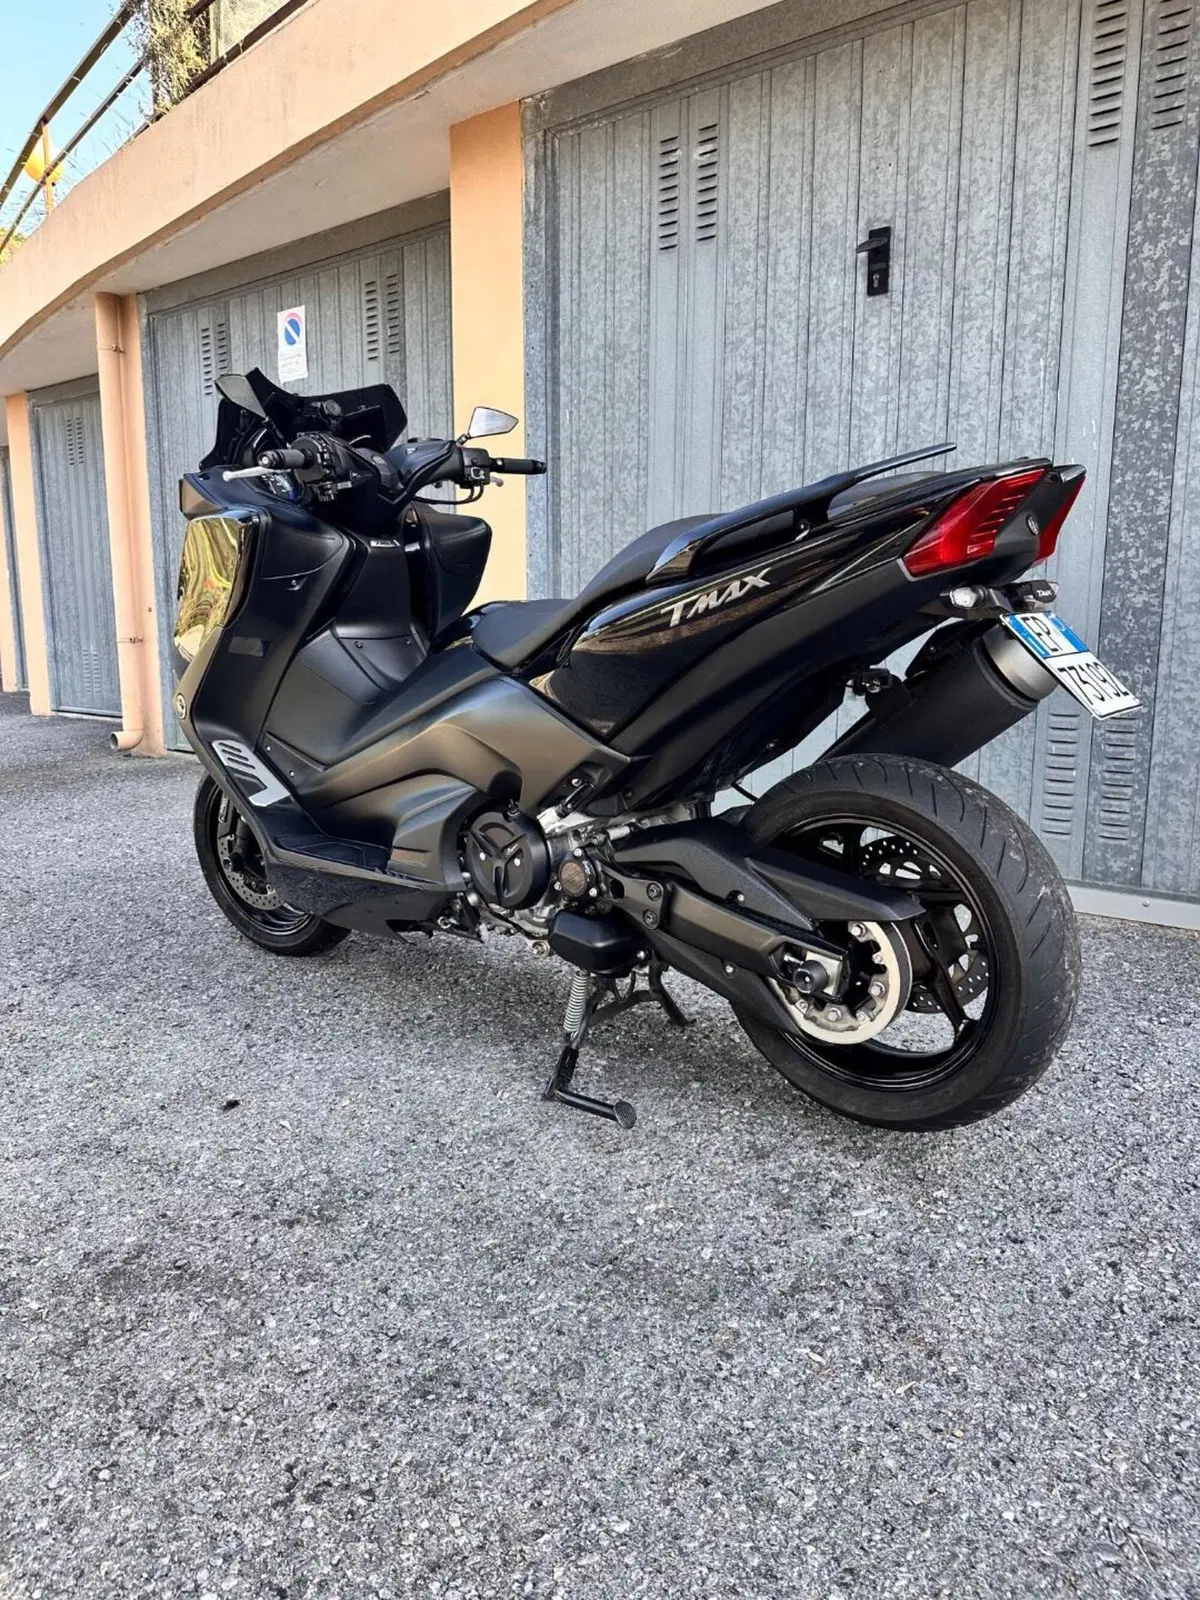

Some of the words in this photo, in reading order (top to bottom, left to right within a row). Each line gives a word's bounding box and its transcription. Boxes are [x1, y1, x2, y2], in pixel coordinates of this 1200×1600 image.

[660, 566, 772, 628] TMAX
[1021, 615, 1063, 652] EP
[1057, 661, 1130, 706] 73192
